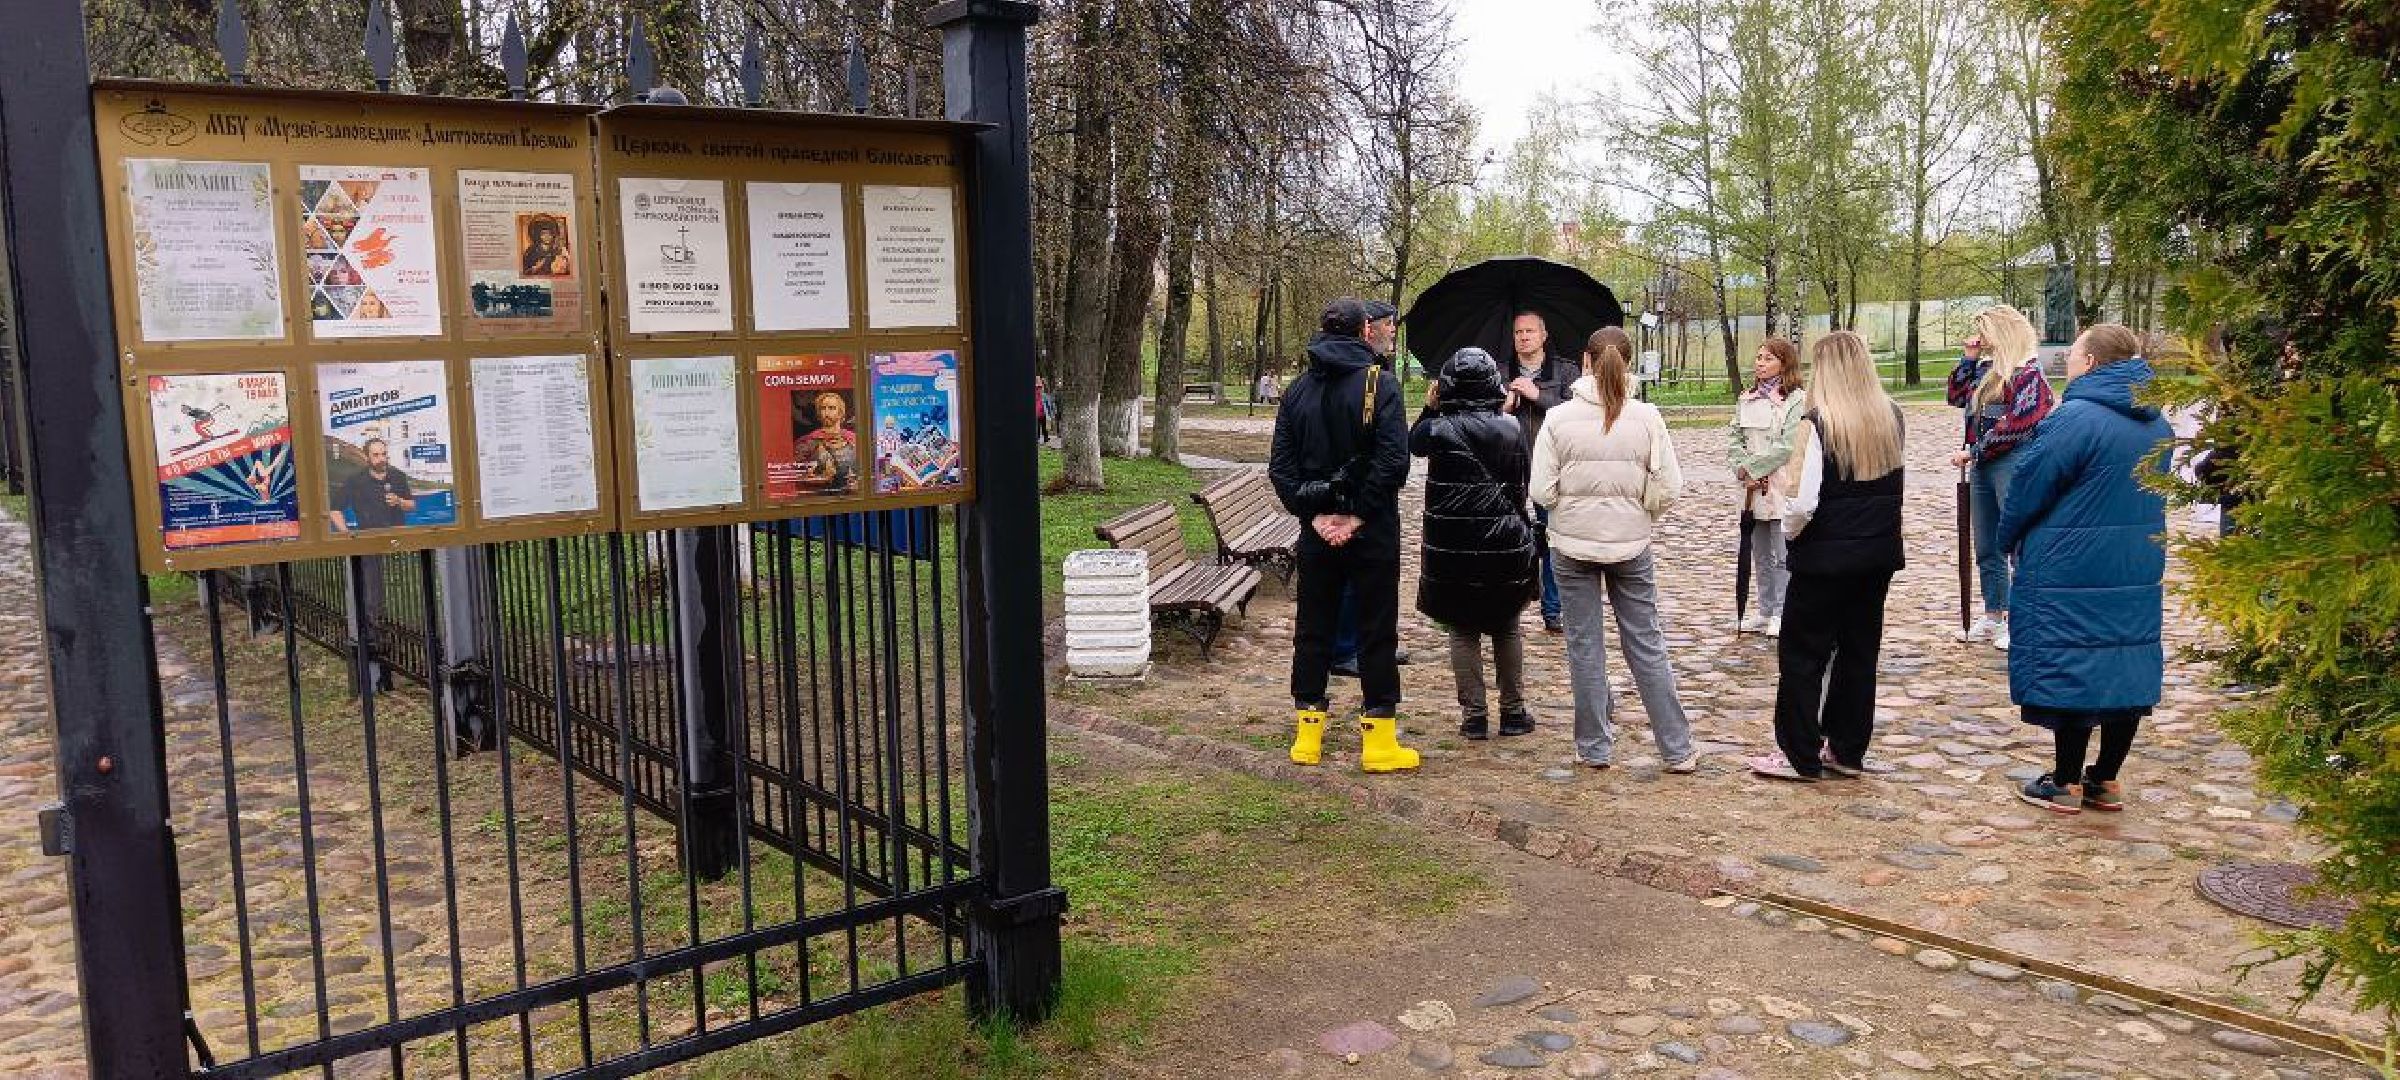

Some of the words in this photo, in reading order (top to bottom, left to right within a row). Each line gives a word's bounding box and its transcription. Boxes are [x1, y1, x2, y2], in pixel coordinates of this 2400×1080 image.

[206, 113, 249, 142] МБУ
[612, 134, 693, 158] Церковь
[703, 137, 764, 158] святой
[770, 147, 858, 165] праведной
[764, 375, 794, 387] СОЛЬ
[329, 389, 400, 416] ДМИТРОВ
